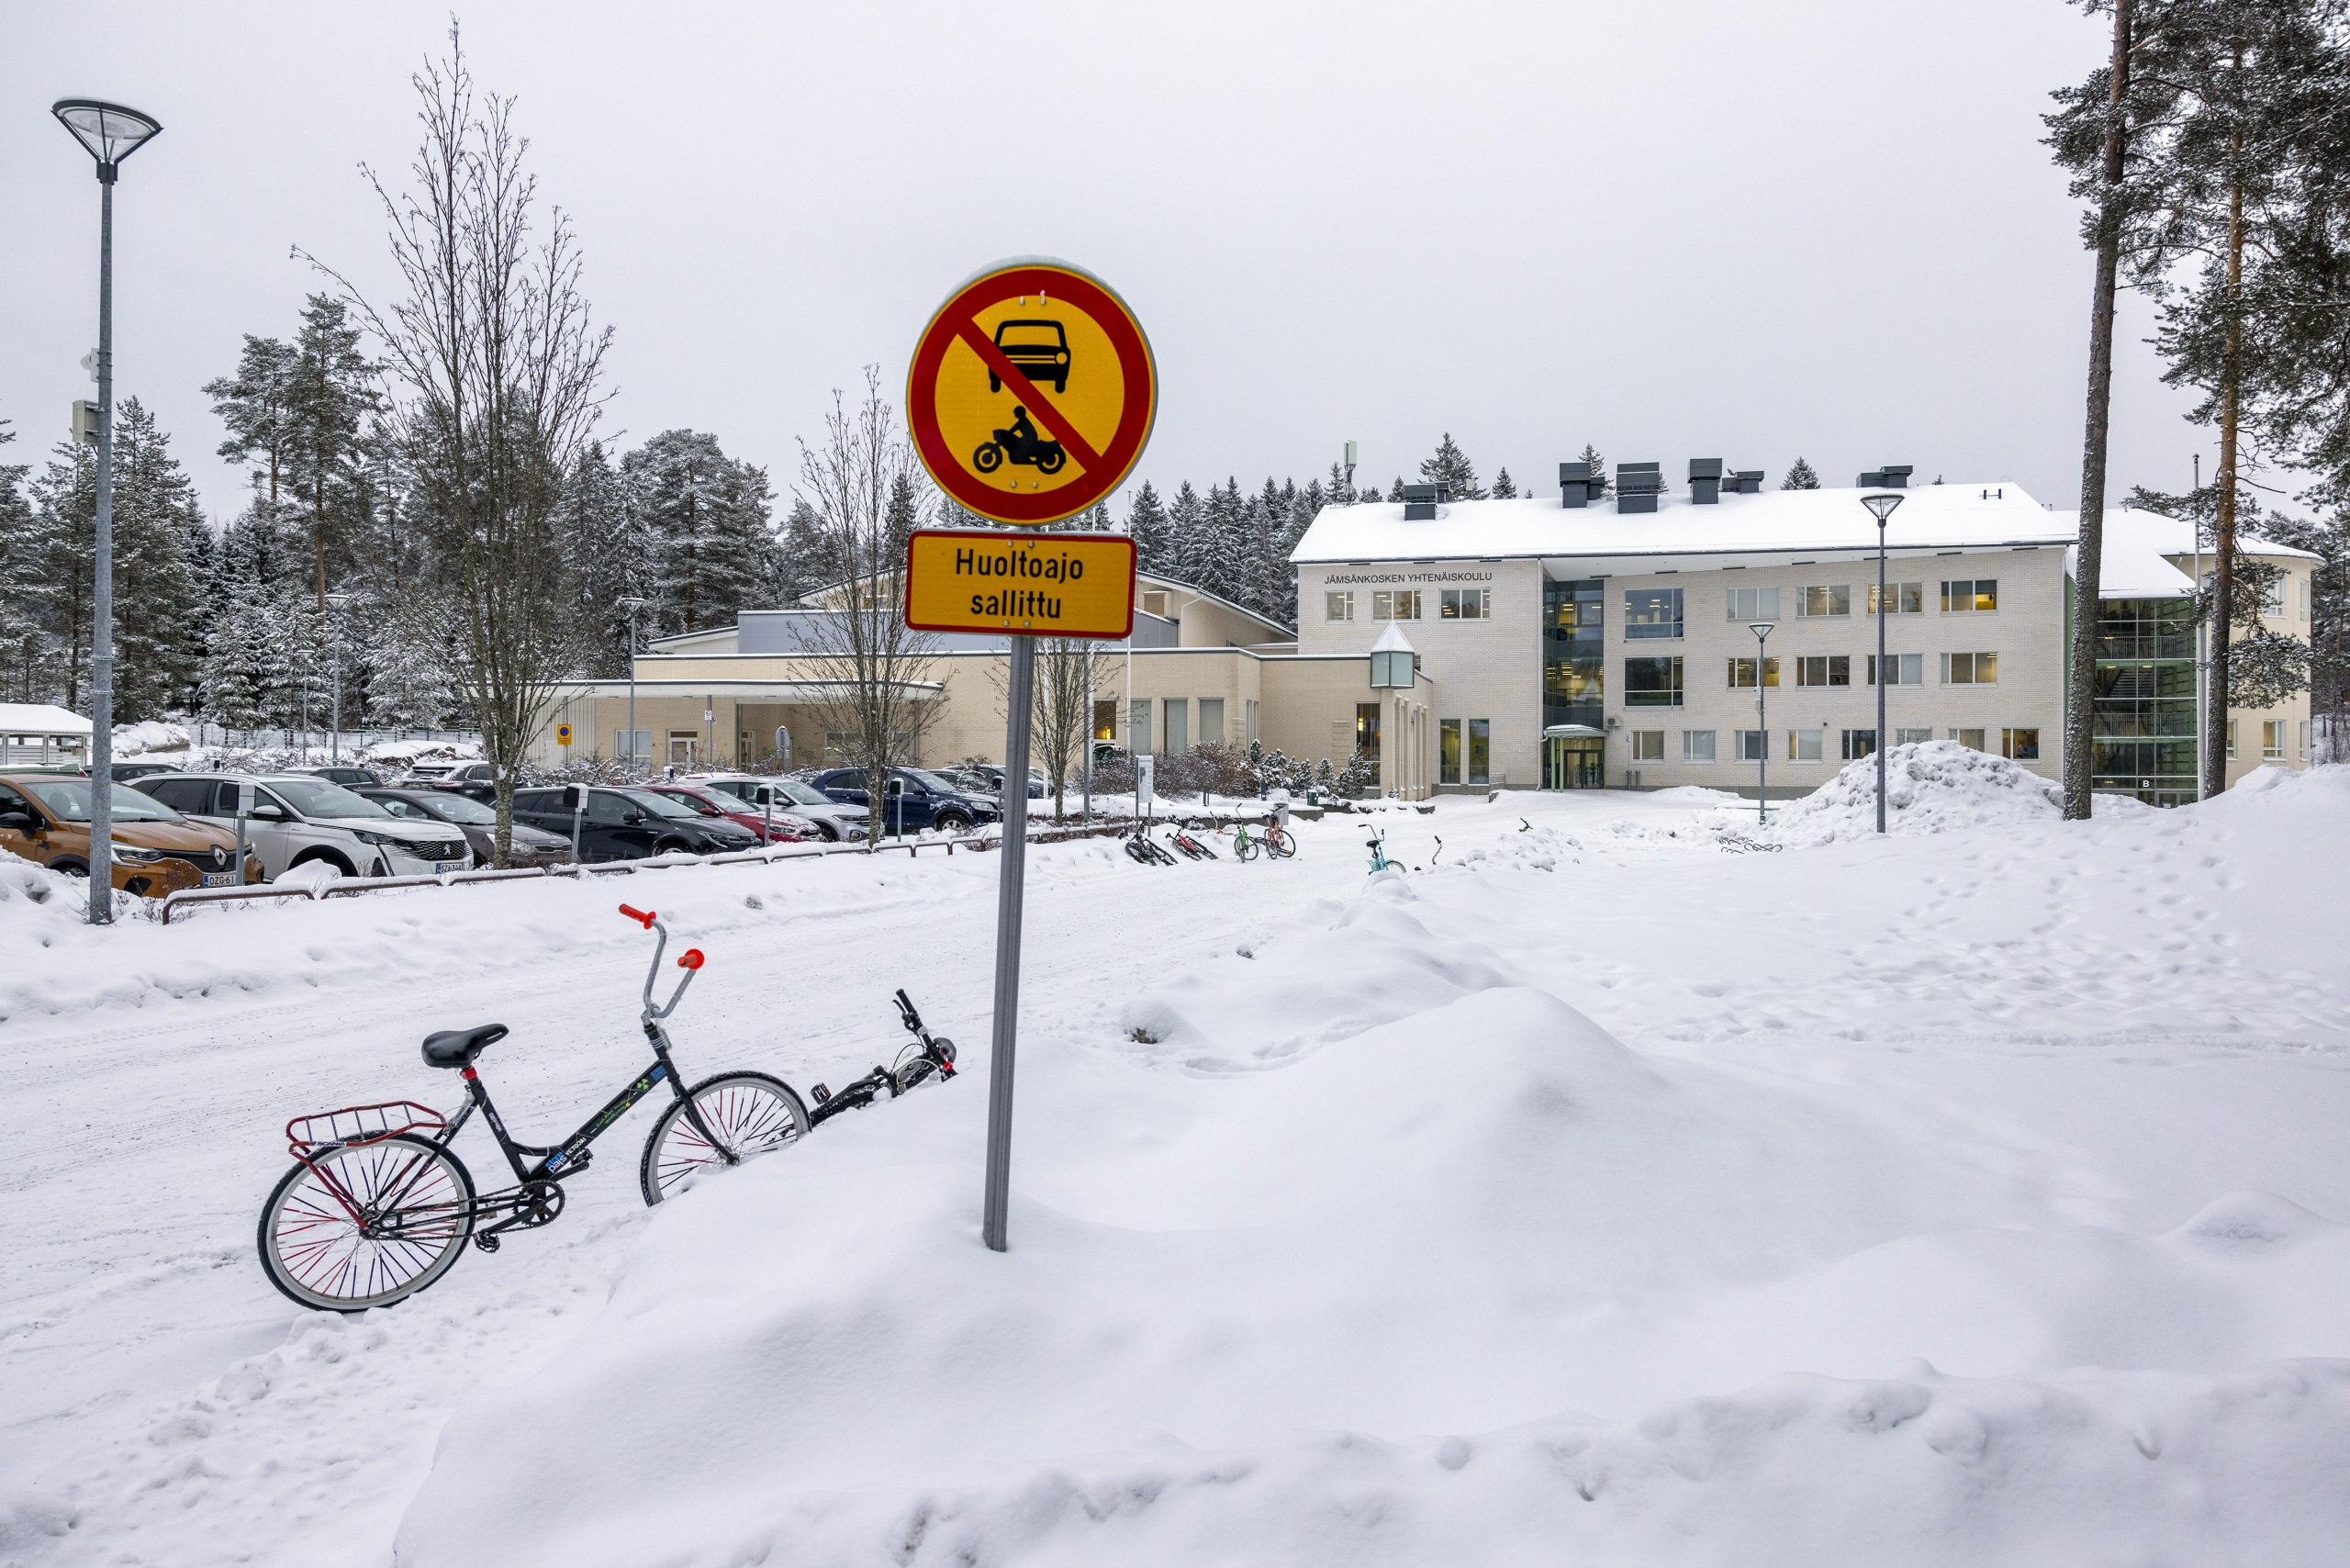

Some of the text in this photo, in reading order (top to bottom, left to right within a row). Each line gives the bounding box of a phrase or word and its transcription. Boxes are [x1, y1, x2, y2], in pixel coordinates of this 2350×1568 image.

[956, 548, 1083, 584] Huoltoajo
[1325, 572, 1493, 585] JÄMSÄNKOSKEN YHTENÄISKOULU
[970, 589, 1061, 619] sallittu
[2143, 779, 2150, 788] B
